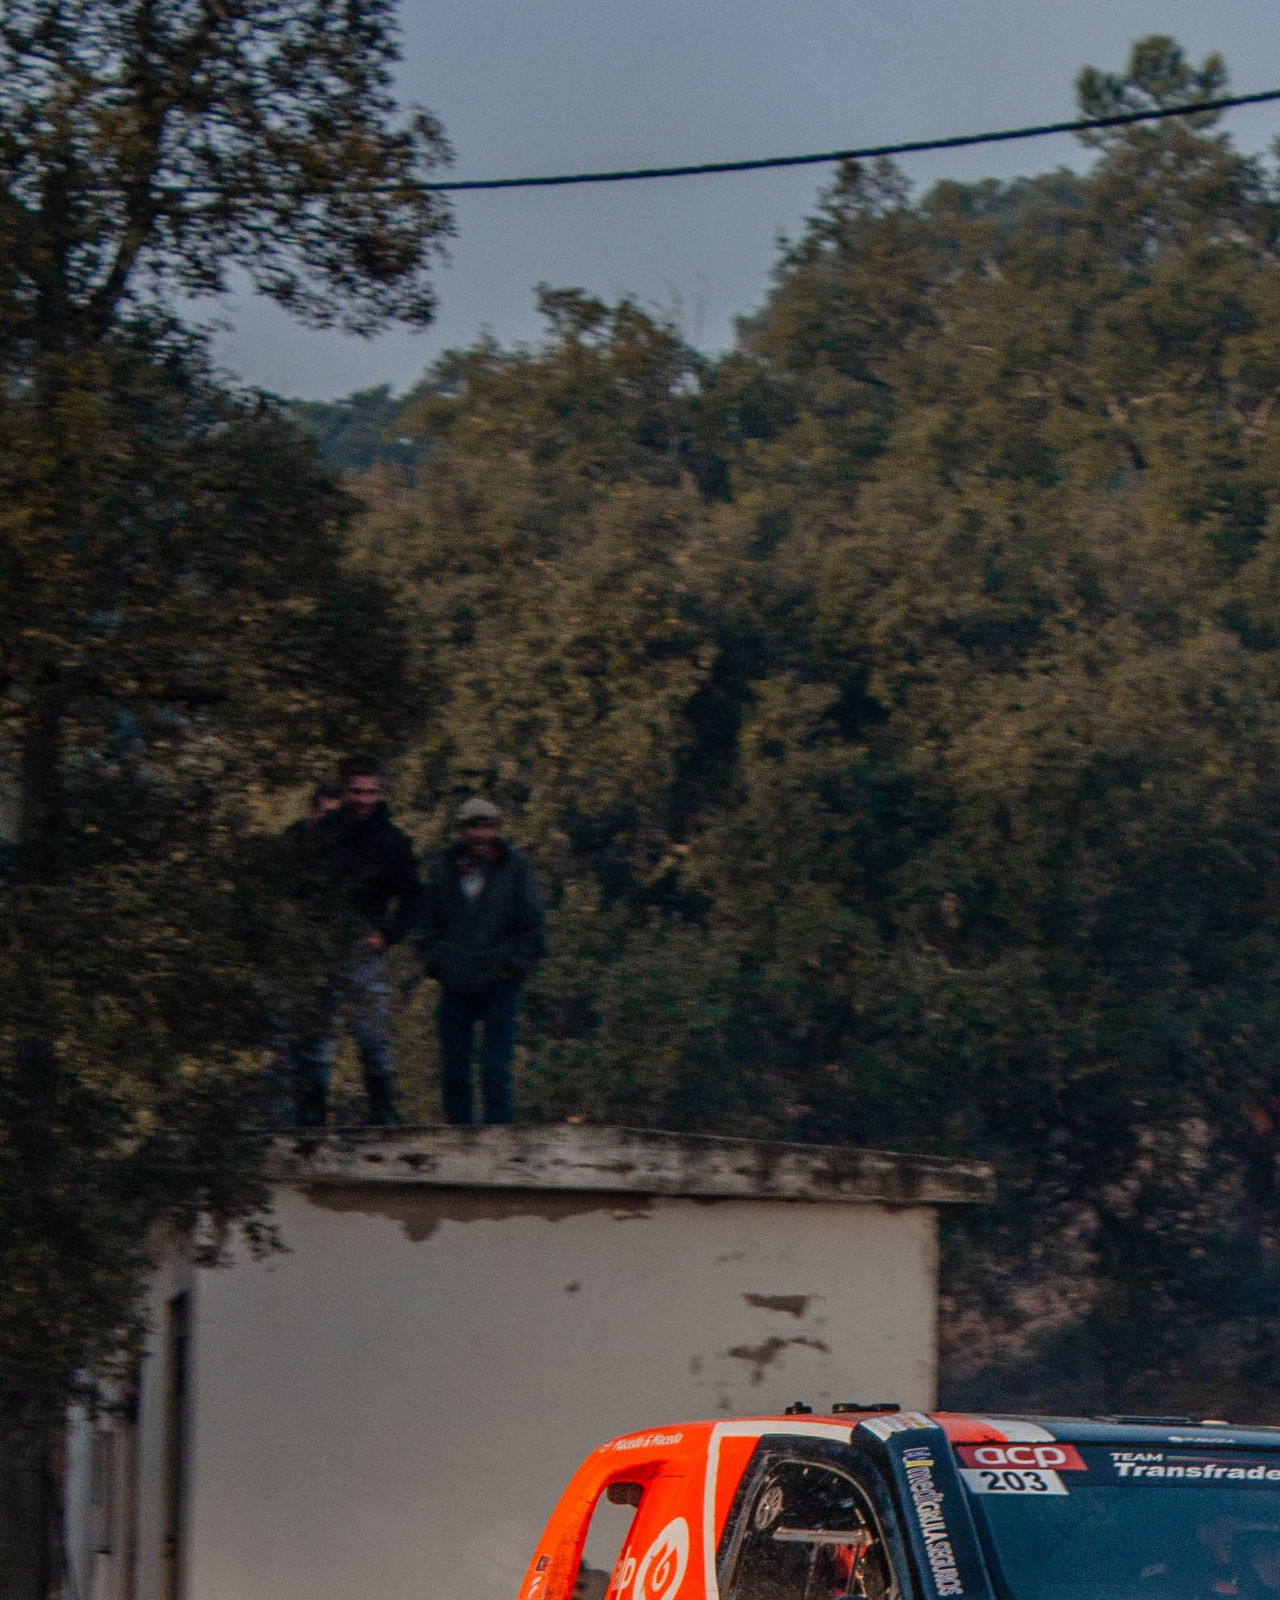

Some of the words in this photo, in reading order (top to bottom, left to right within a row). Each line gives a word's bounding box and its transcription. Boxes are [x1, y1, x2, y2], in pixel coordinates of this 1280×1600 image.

[973, 1446, 1067, 1468] acp
[1110, 1452, 1163, 1462] TEAM
[980, 1471, 1048, 1491] 203
